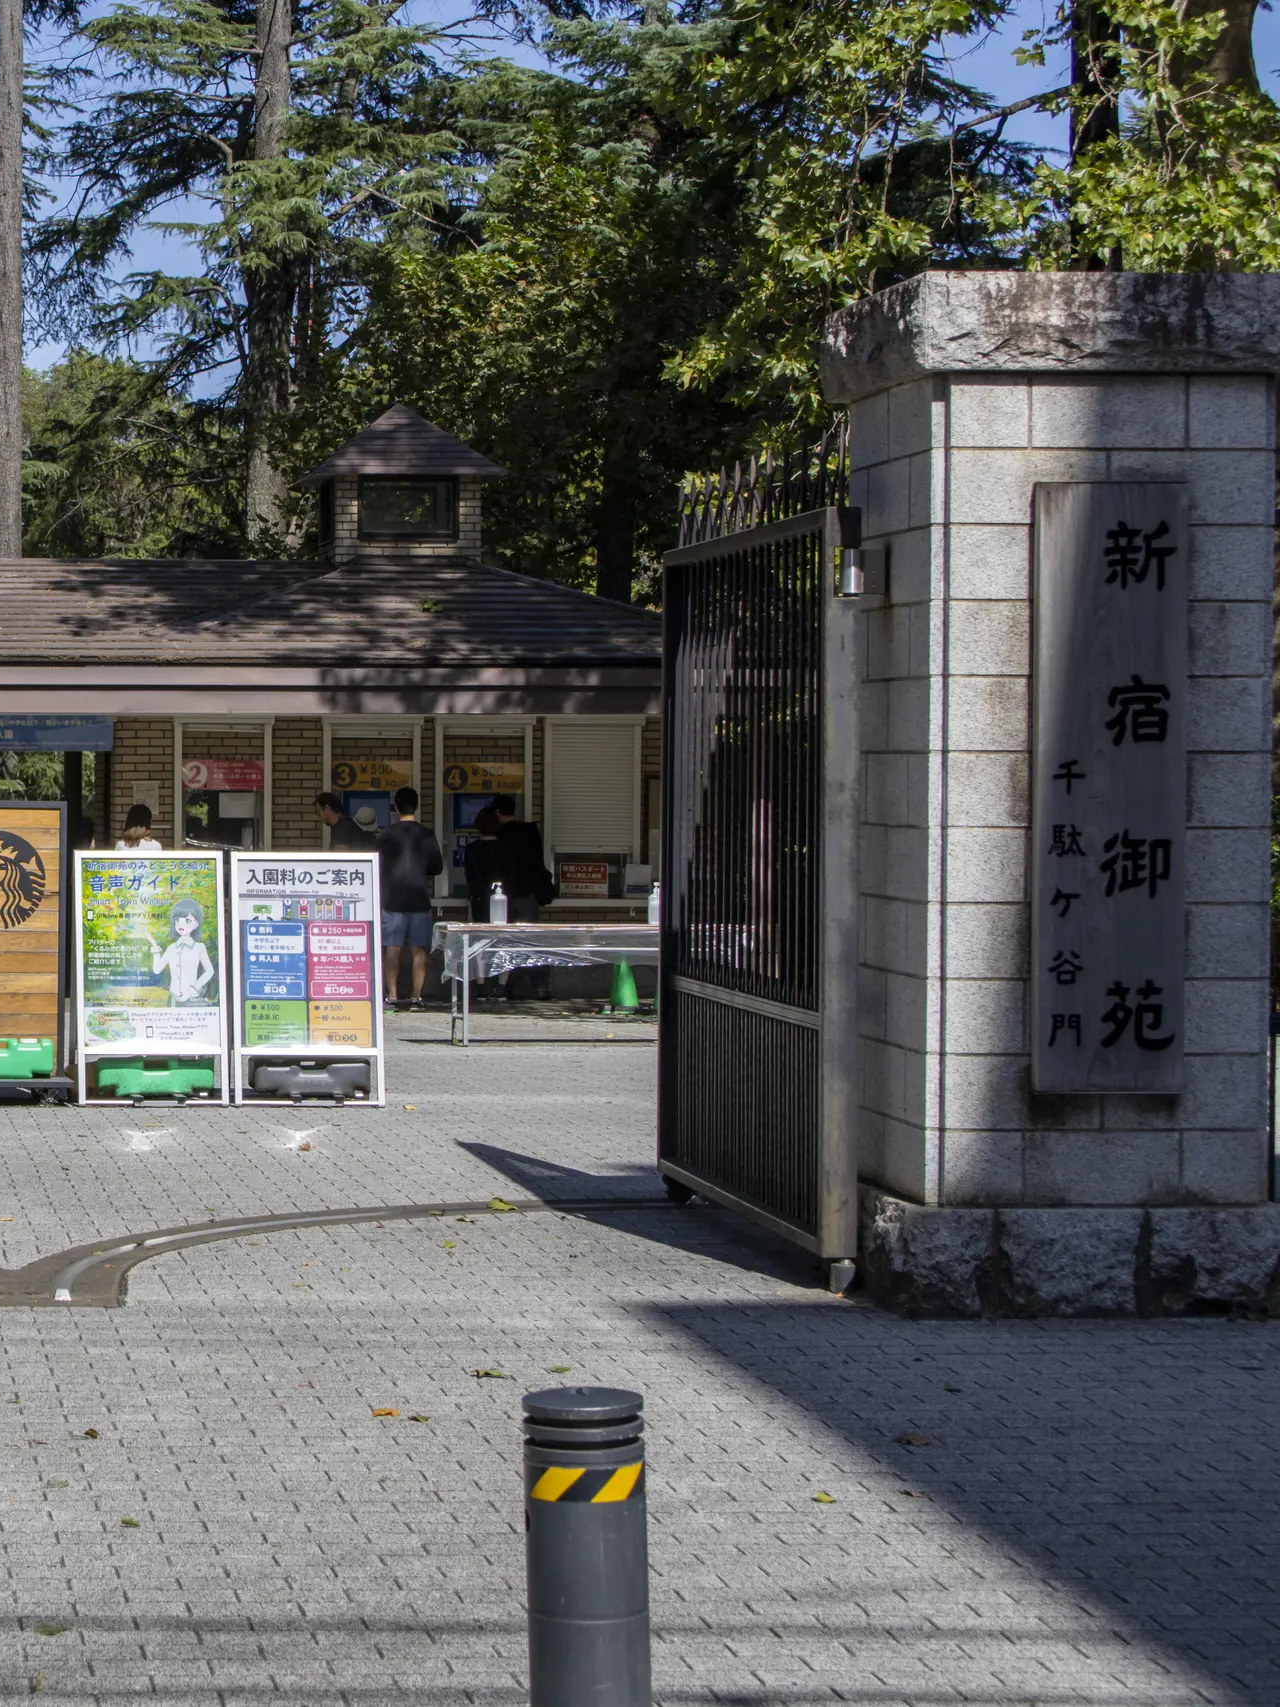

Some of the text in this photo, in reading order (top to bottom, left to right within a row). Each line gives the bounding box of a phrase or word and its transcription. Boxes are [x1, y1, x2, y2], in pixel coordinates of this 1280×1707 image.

[1100, 520, 1178, 1051] 新宿御苑
[87, 861, 208, 871] 新宿御苑のみどころを紹介
[245, 868, 365, 886] 入園料のご案内
[89, 874, 181, 892] 音声ガイド
[89, 896, 170, 906] Smart Town Walker
[258, 926, 273, 934] 無料
[258, 955, 280, 963] 再入園
[320, 955, 354, 963] 年パス購入
